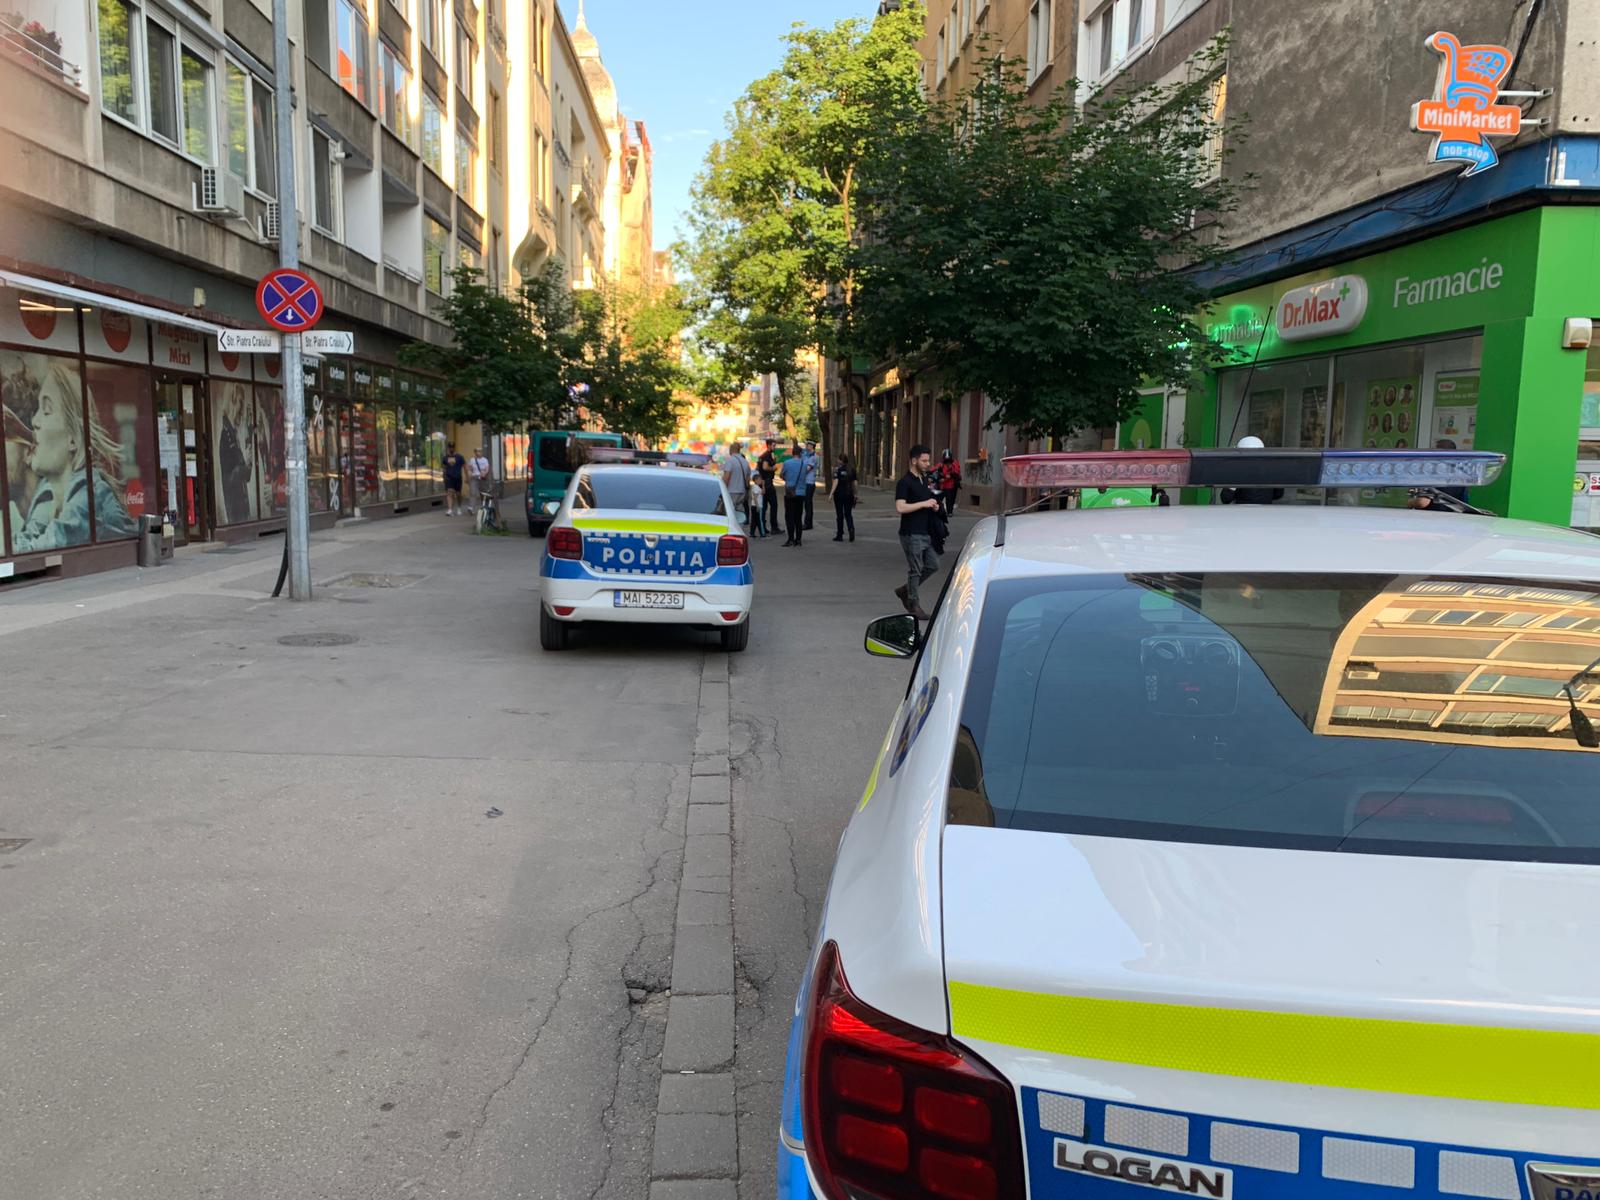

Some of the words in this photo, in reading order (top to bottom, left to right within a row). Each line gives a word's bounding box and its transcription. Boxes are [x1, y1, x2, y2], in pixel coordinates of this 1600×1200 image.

[1423, 107, 1513, 129] MiniMarket
[1442, 145, 1489, 161] non-stop
[1393, 257, 1504, 308] Farmacie
[1282, 296, 1341, 329] Dr.Max
[169, 347, 191, 366] Mixt
[602, 547, 704, 567] POLITIA
[623, 592, 641, 604] MAI
[645, 593, 680, 605] 52236
[1057, 1142, 1225, 1198] LOGAN
